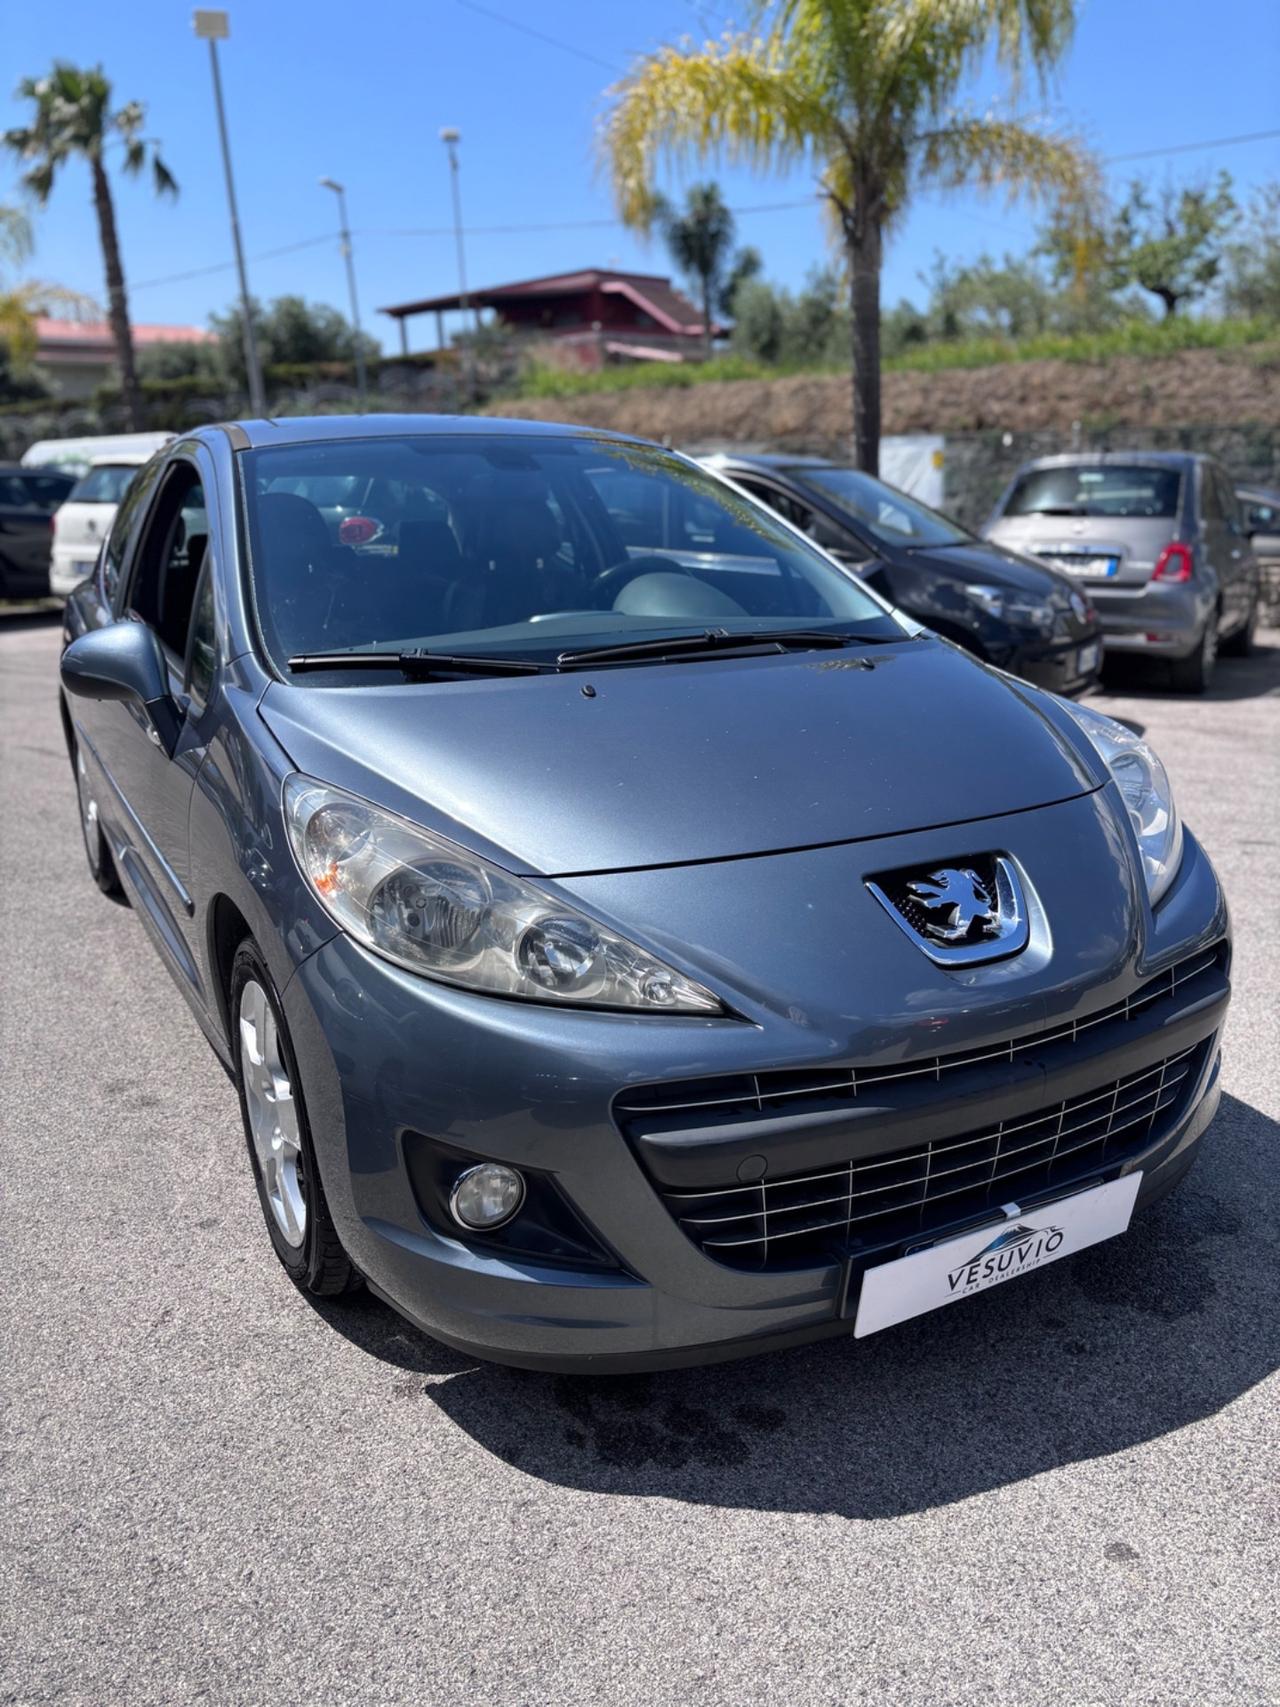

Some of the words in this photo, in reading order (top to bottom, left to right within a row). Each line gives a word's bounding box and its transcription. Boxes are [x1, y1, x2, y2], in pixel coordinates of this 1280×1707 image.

[948, 1232, 1063, 1291] VESUVIO
[962, 1283, 980, 1294] CAR
[988, 1258, 1041, 1284] DEALERSHIP
